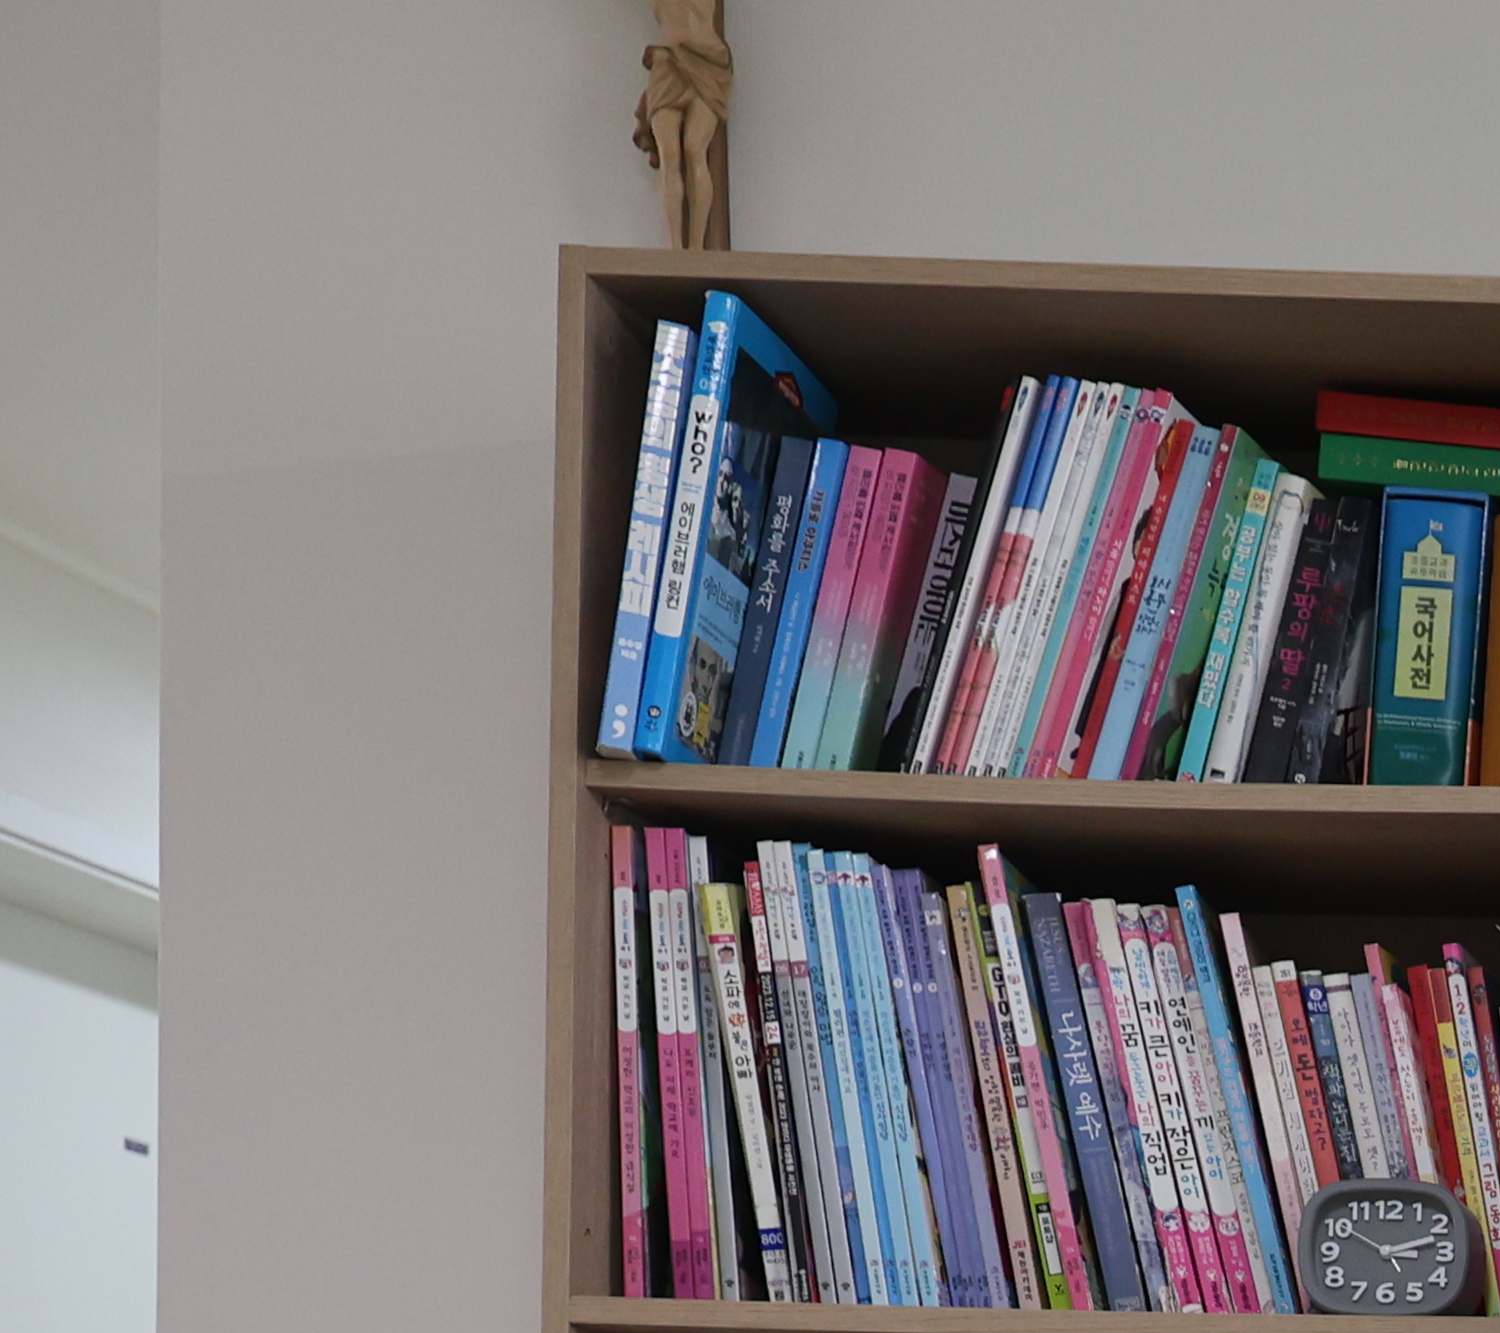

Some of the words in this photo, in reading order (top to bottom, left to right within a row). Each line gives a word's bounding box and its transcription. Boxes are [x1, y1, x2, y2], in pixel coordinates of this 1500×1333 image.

[666, 578, 682, 610] 링컨
[756, 558, 781, 613] 주소서
[1411, 597, 1437, 690] 국어사전
[1115, 994, 1130, 1018] 나의
[1138, 1001, 1162, 1029] 키가
[1307, 1001, 1328, 1013] 학년
[1120, 1024, 1138, 1047] 꿈
[1148, 1035, 1169, 1056] 큰
[1057, 1010, 1087, 1086] 나사렛
[1073, 1091, 1103, 1141] 예수
[1155, 1062, 1173, 1085] 아이
[1296, 1055, 1315, 1082] 돈
[1137, 1102, 1155, 1126] 나의
[1160, 1092, 1182, 1122] 키가
[1142, 1132, 1167, 1176] 직업
[1167, 1126, 1194, 1169] 작은
[1206, 1155, 1223, 1180] 아이
[1180, 1174, 1198, 1198] 아이
[1482, 1163, 1498, 1199] 그림
[1348, 1201, 1372, 1221] 11
[1375, 1200, 1403, 1221] 12
[1412, 1202, 1424, 1222] 1
[1325, 1217, 1353, 1238] 10
[1430, 1214, 1449, 1235] 2
[761, 1232, 784, 1245] 800
[1320, 1241, 1340, 1262] 9
[1436, 1240, 1454, 1262] 3
[1325, 1266, 1345, 1287] 8
[1428, 1267, 1448, 1287] 4
[1350, 1281, 1368, 1301] 7
[1375, 1282, 1395, 1303] 6
[1404, 1281, 1424, 1302] 5
